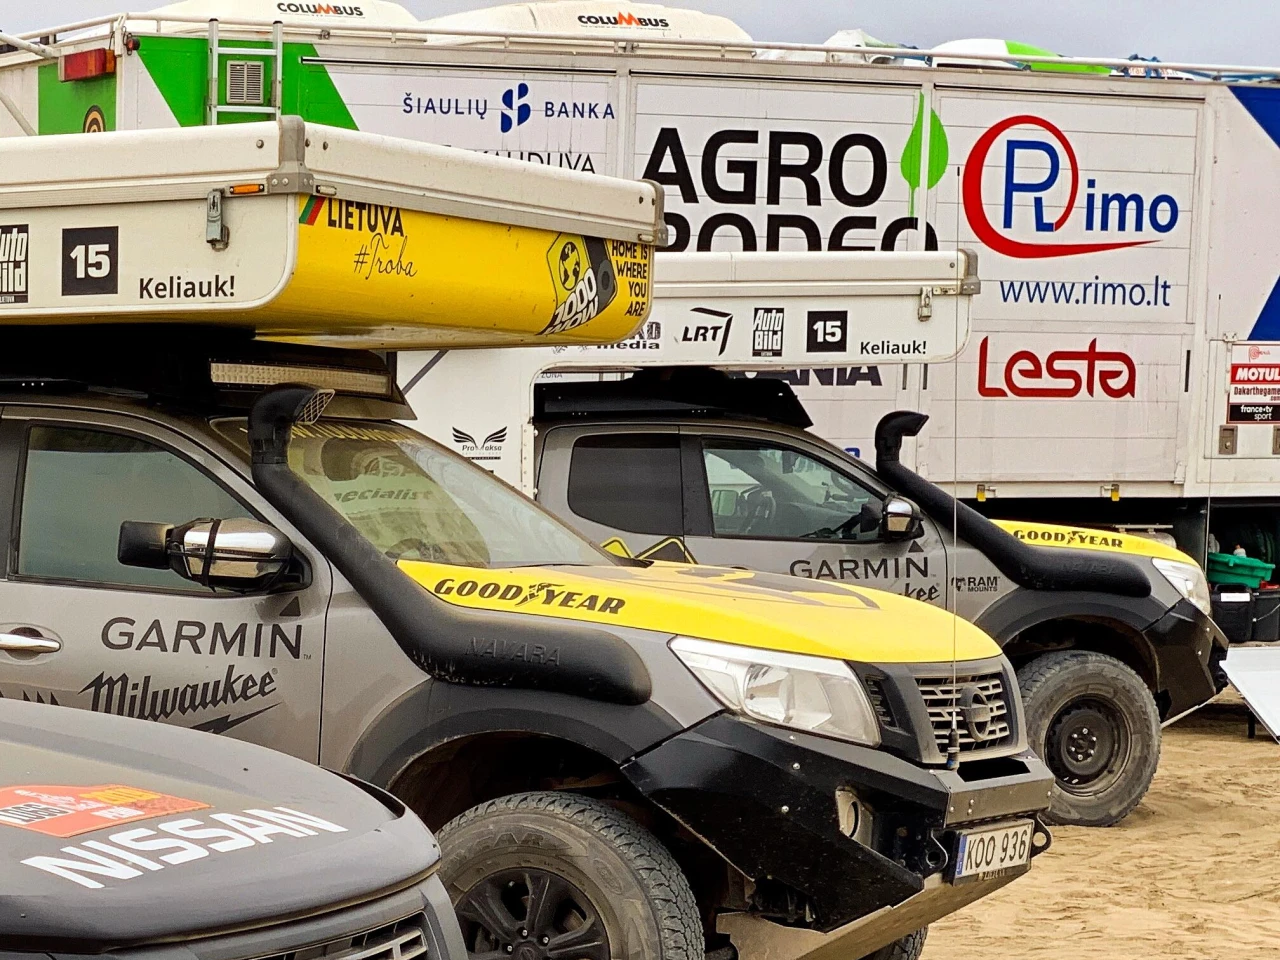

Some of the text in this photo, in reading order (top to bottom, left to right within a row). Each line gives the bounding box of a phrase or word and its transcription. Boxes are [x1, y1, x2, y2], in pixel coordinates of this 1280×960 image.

[277, 3, 364, 17] COLUMBUS
[577, 11, 669, 27] COLUMBUS
[402, 92, 616, 120] ŠIAULIŲ BANKA
[642, 127, 888, 208] AGRO
[327, 198, 405, 238] LIETUVA
[69, 243, 111, 279] 15
[611, 240, 648, 261] HOME IS
[615, 260, 647, 280] WHERE
[138, 275, 236, 300] Keliauk!
[628, 281, 647, 298] YOU
[999, 274, 1171, 307] www.rimo.lt
[624, 301, 646, 317] ARE
[753, 309, 784, 331] Auto
[681, 325, 723, 342] LRT
[754, 330, 783, 351] Bild
[812, 320, 842, 343] 15
[859, 340, 927, 356] Keliauk!
[977, 335, 1137, 399] Lesta
[1253, 413, 1272, 421] sport
[789, 556, 929, 580] GARMIN
[967, 576, 998, 587] RAM
[100, 616, 303, 659] GARMIN
[77, 664, 278, 722] Milwaukee
[19, 806, 349, 889] NISSAN
[965, 829, 1028, 871] KOO 936
